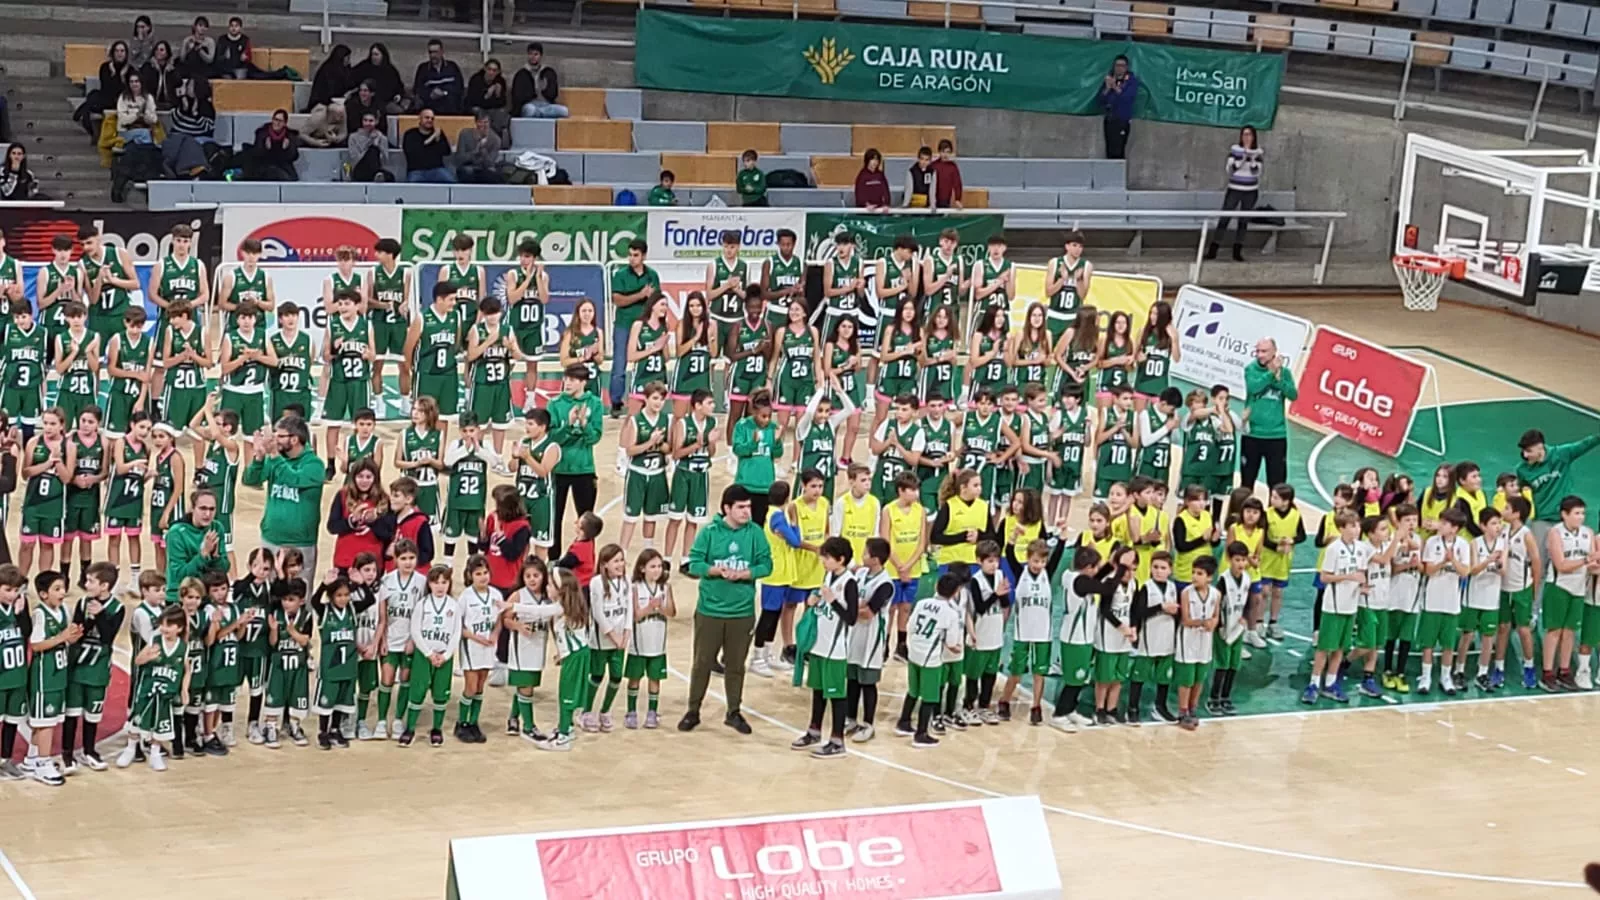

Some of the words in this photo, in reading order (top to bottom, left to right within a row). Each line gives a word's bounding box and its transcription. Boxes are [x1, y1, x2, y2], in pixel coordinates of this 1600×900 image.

[863, 45, 924, 68] CAJA
[930, 48, 1009, 73] RURAL
[879, 72, 905, 88] DE
[910, 73, 991, 93] ARAGÓN
[1211, 70, 1247, 91] San
[1175, 86, 1247, 107] Lorenzo
[102, 290, 115, 310] 17
[722, 294, 739, 312] 14
[943, 288, 952, 304] 3
[1060, 290, 1075, 308] 18
[54, 305, 66, 324] 4
[520, 304, 540, 322] 00
[1217, 332, 1249, 355] rivas
[343, 357, 364, 378] 22
[437, 348, 447, 368] 8
[646, 356, 662, 372] 33
[690, 356, 705, 372] 31
[746, 356, 764, 373] 28
[18, 366, 30, 387] 3
[245, 367, 256, 386] 2
[486, 363, 506, 381] 33
[899, 360, 912, 377] 16
[937, 365, 951, 380] 15
[988, 363, 1002, 380] 13
[1028, 366, 1042, 381] 12
[1146, 359, 1164, 377] 00
[175, 370, 197, 388] 20
[279, 371, 300, 390] 99
[1113, 370, 1122, 386] 5
[1319, 369, 1393, 417] Lobe
[965, 453, 987, 472] 27
[1112, 445, 1127, 465] 10
[1154, 449, 1168, 468] 31
[1198, 445, 1208, 461] 3
[1220, 446, 1235, 462] 77
[816, 456, 832, 477] 41
[39, 478, 49, 496] 8
[124, 478, 140, 497] 14
[460, 476, 480, 495] 32
[153, 488, 165, 507] 28
[246, 623, 262, 642] 17
[913, 613, 939, 639] 54
[3, 645, 26, 670] 00
[76, 643, 102, 666] 77
[223, 646, 237, 667] 13
[282, 654, 300, 671] 10
[340, 645, 347, 665] 1
[91, 701, 104, 713] 77
[297, 697, 309, 709] 10
[637, 848, 699, 868] GRUPO
[710, 828, 905, 880] Lobe
[740, 884, 776, 900] HIGH
[781, 879, 838, 897] QUALITY
[845, 875, 894, 891] HOMES
